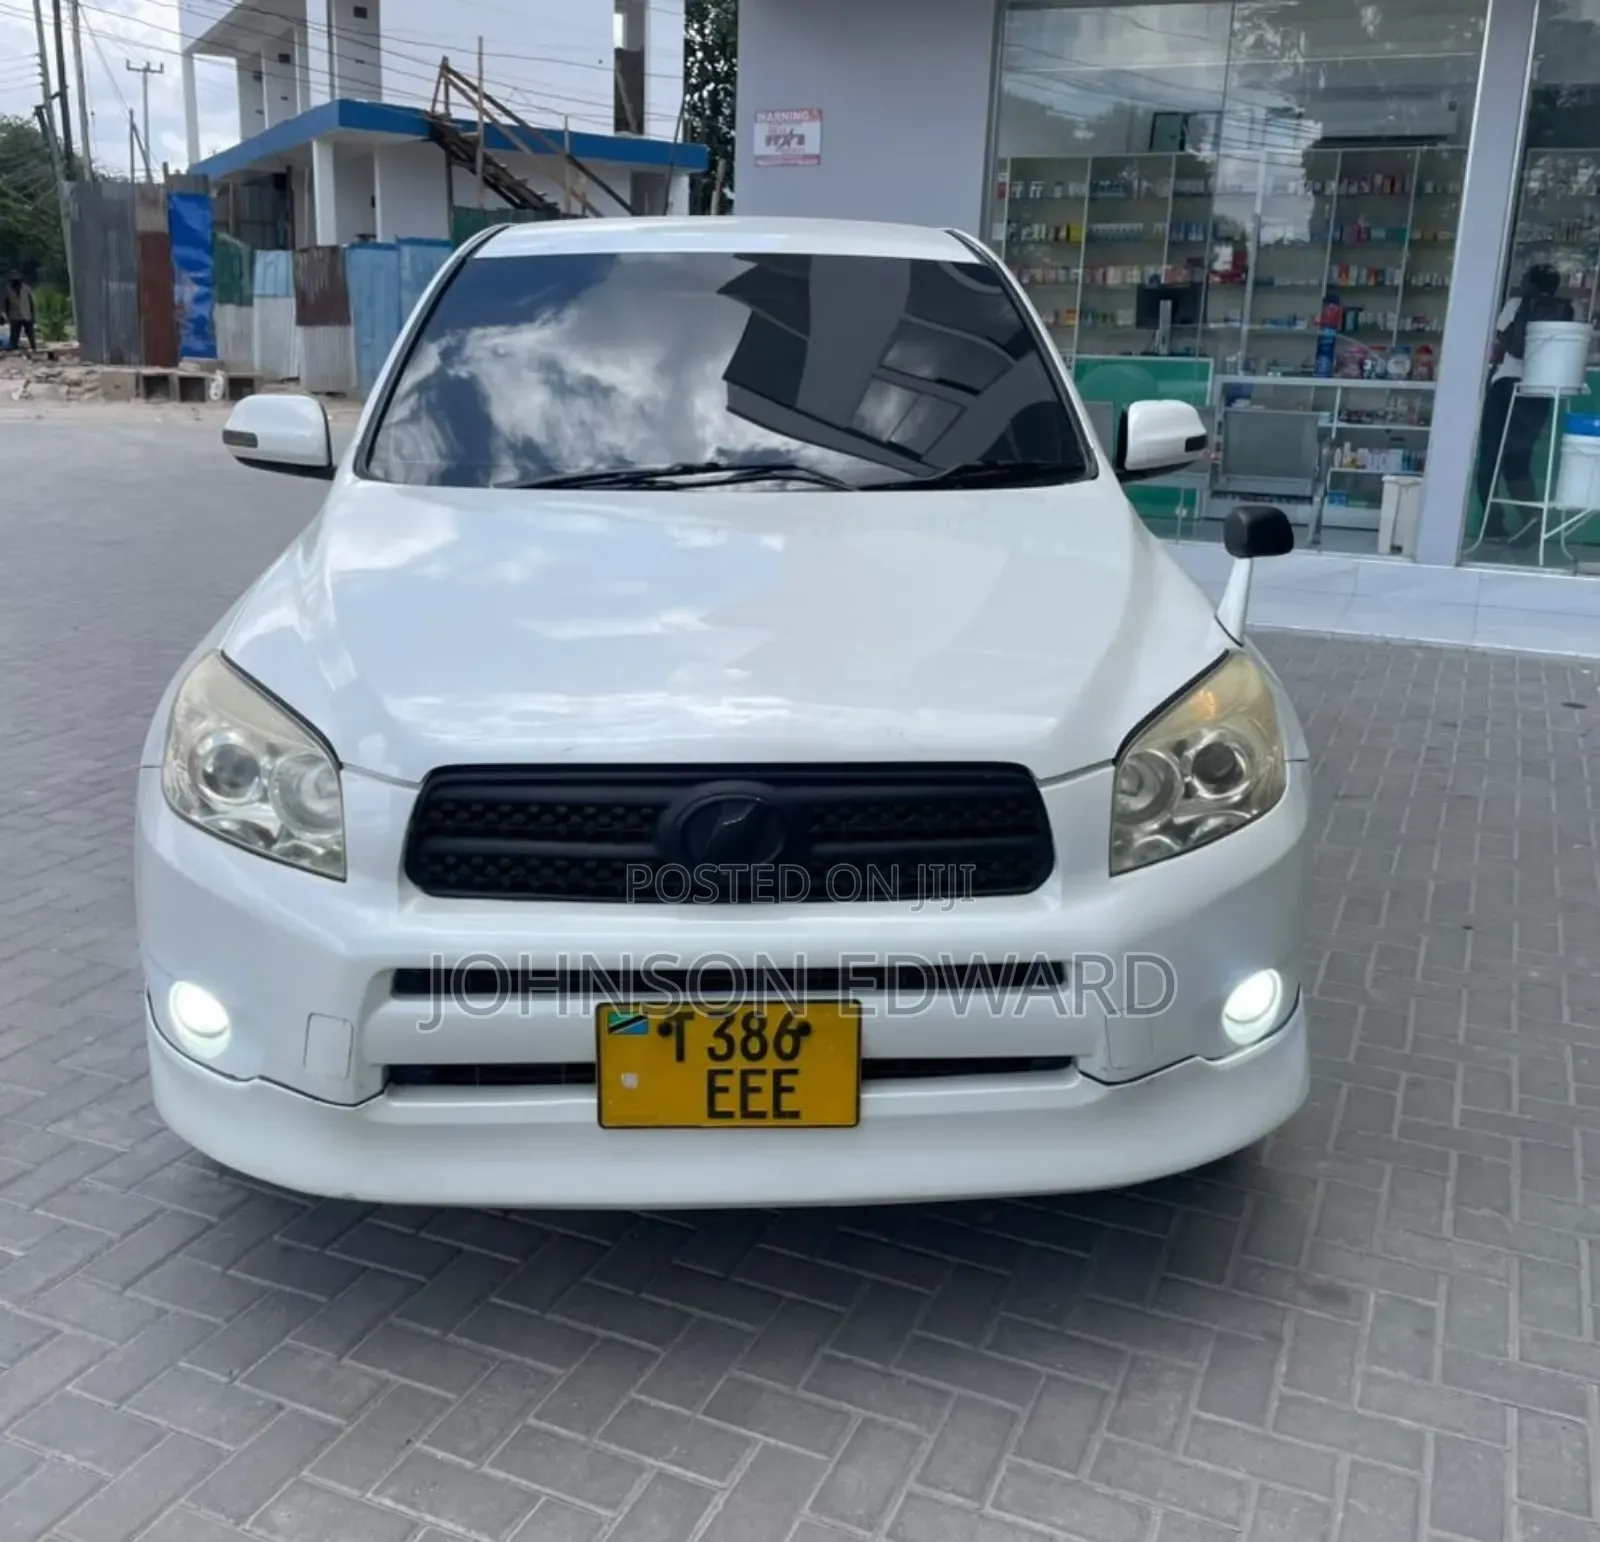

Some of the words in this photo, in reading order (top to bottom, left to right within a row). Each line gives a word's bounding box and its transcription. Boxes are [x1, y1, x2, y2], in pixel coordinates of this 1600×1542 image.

[666, 1011, 695, 1063] T
[706, 1010, 803, 1062] 386
[706, 1068, 801, 1119] EEE
